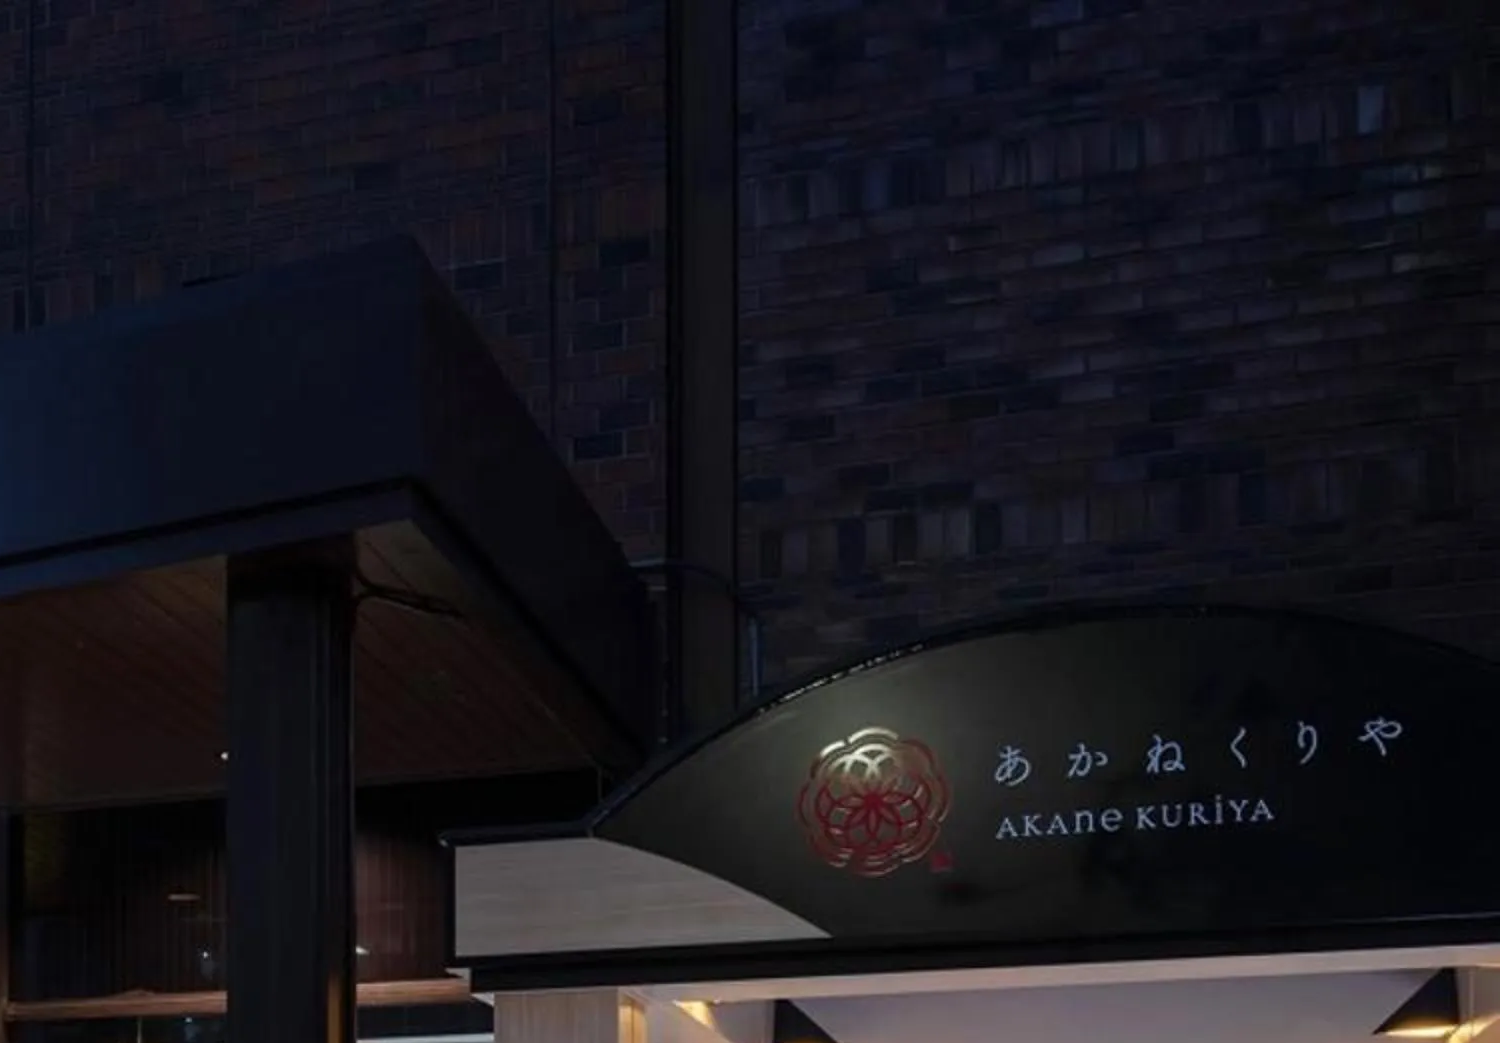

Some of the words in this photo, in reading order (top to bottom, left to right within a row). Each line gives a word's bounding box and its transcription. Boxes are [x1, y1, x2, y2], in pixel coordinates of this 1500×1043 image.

[994, 717, 1404, 788] あかねくりや
